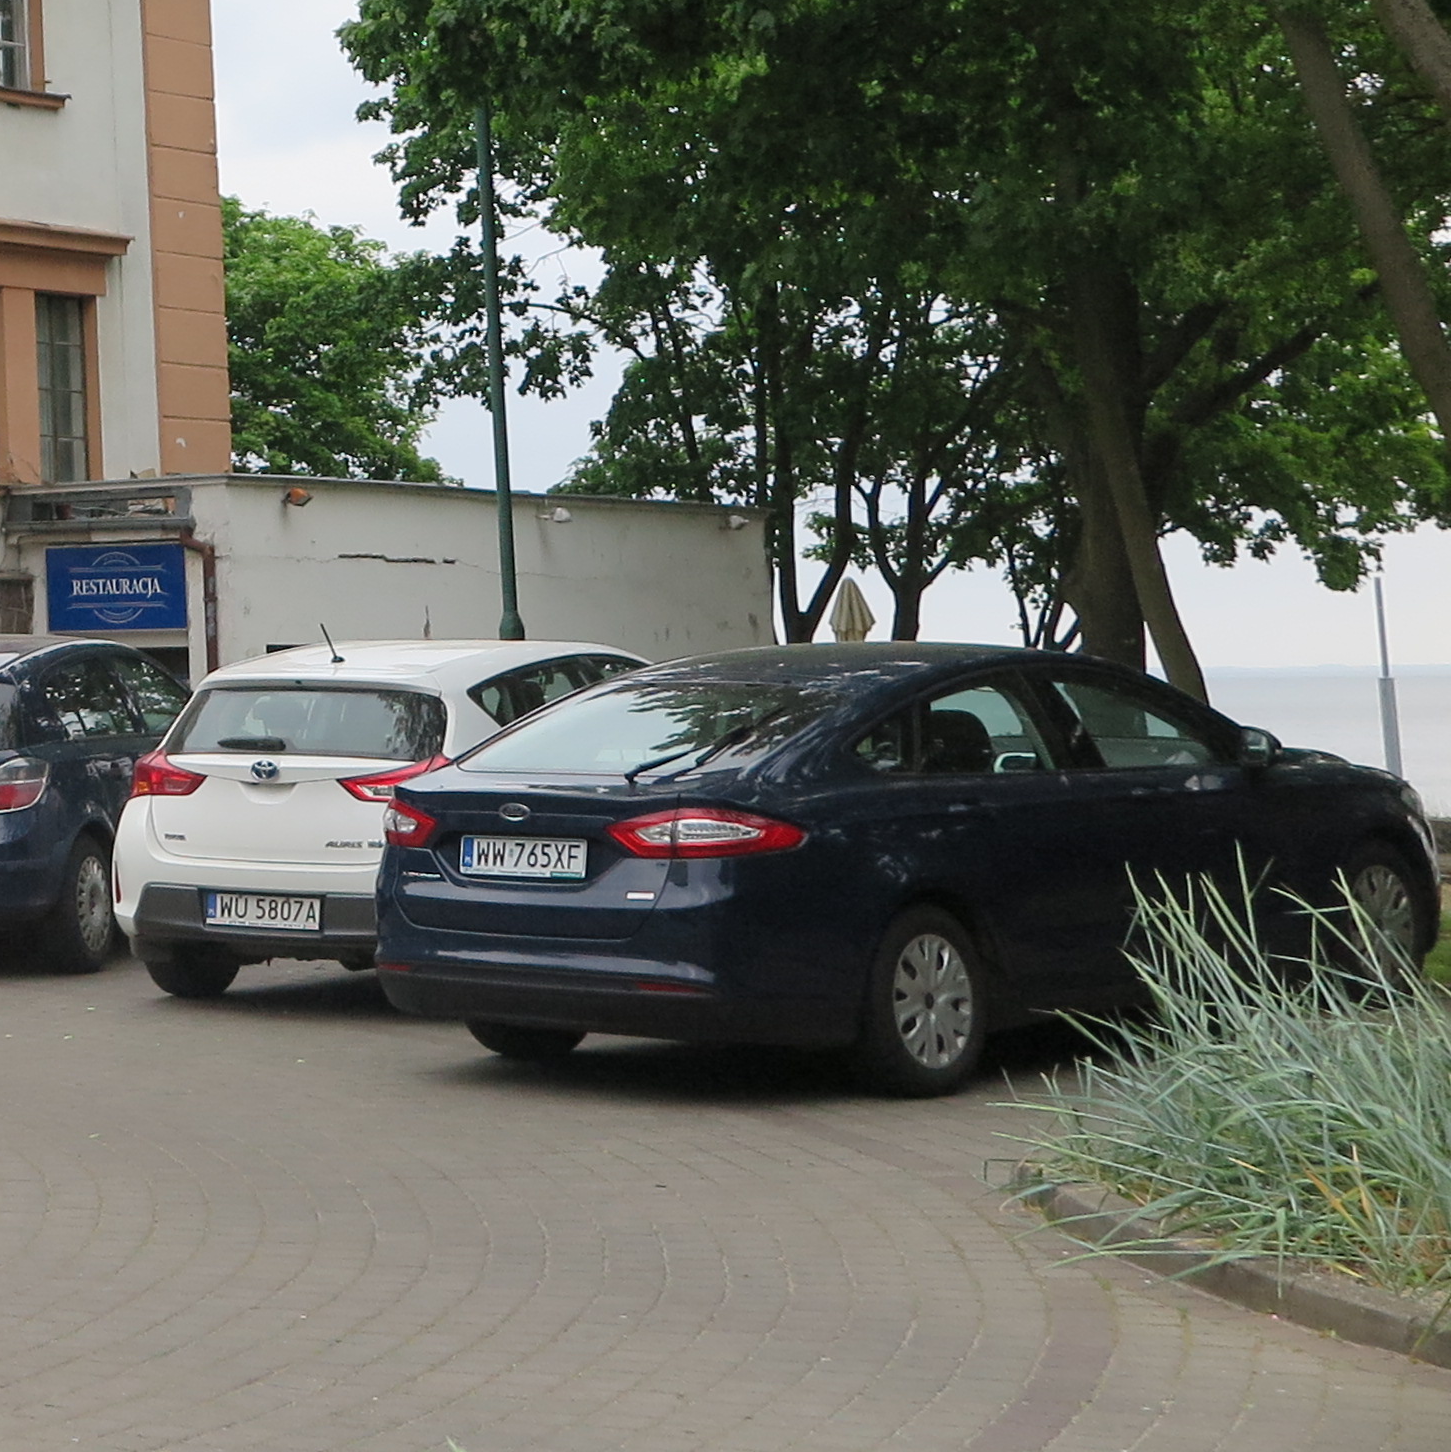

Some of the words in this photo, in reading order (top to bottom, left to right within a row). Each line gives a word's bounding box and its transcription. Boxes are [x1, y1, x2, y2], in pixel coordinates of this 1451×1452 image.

[71, 577, 161, 598] RESTAURACJA
[477, 841, 506, 867] WW
[514, 842, 582, 869] 765XF
[220, 895, 248, 918] WU
[255, 898, 317, 923] 5807A
